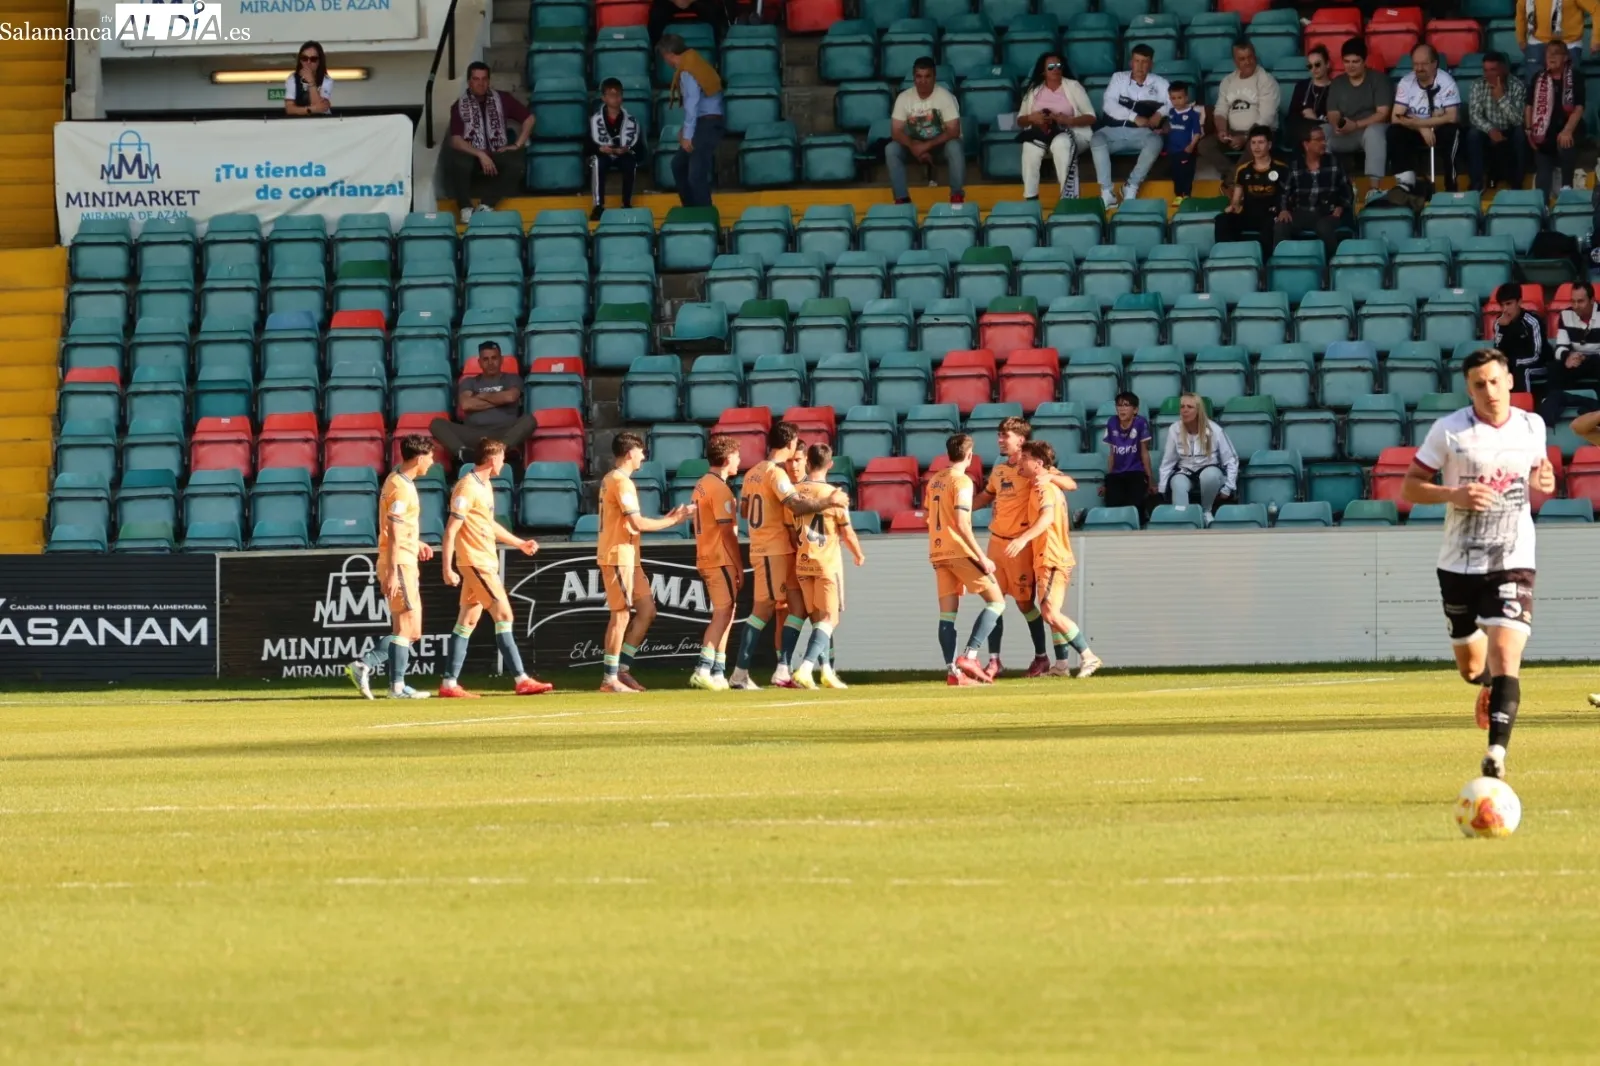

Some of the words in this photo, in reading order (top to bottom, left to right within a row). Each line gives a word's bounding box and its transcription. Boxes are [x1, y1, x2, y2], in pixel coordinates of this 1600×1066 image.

[240, 0, 316, 13] MIRANDA
[321, 0, 341, 11] DE
[215, 164, 248, 182] ¡Tu
[255, 161, 327, 178] tienda
[65, 190, 200, 208] MINIMARKET
[256, 184, 283, 200] de
[289, 180, 405, 200] confianza!
[80, 211, 135, 220] MIRANDA
[138, 211, 153, 220] DE
[559, 569, 714, 613] ALMA
[9, 603, 46, 611] CALIDAD
[261, 634, 452, 661] MINIMAET
[570, 639, 592, 659] El
[652, 643, 674, 652] una
[282, 664, 347, 679] MIRAND
[402, 660, 435, 676] ZÁN
